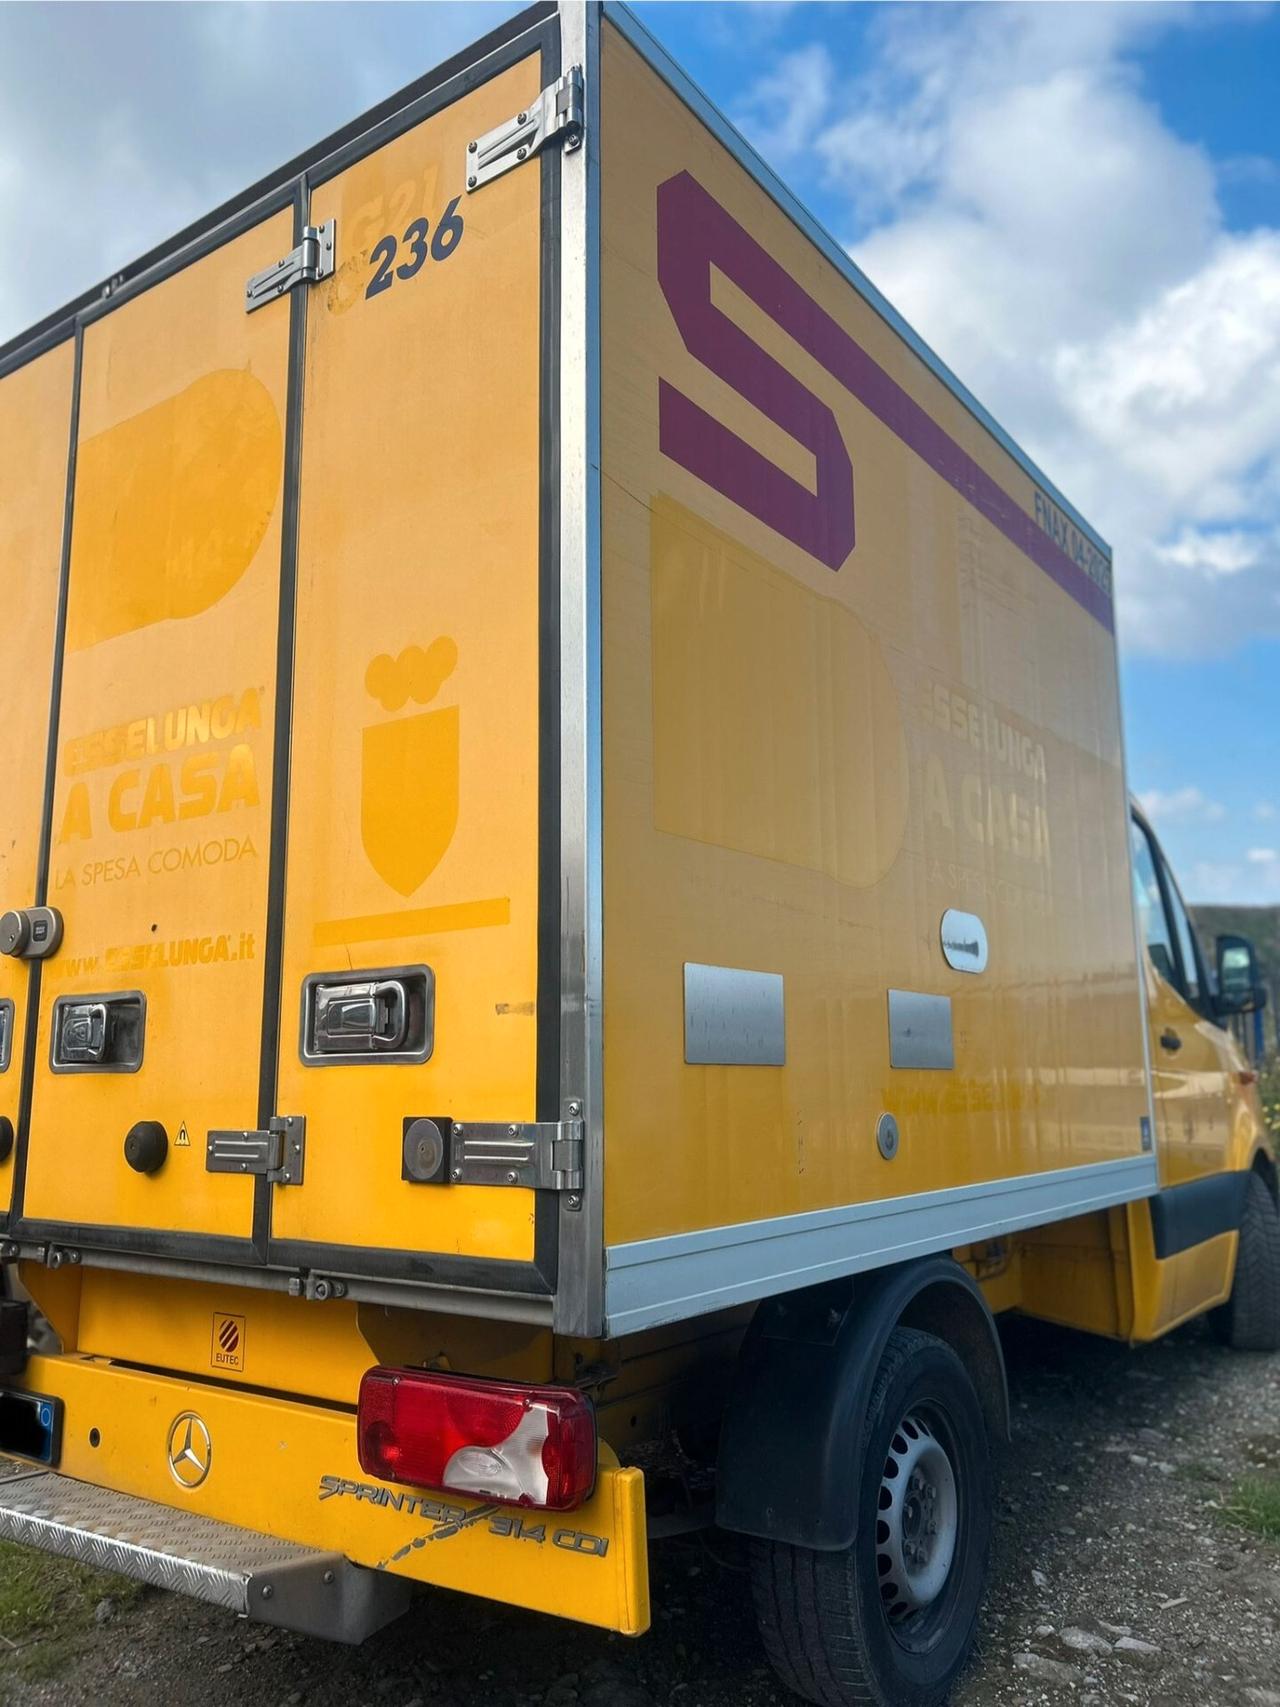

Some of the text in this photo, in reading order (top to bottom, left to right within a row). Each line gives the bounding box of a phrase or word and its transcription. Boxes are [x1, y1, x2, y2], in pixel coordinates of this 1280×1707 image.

[365, 195, 464, 300] 236
[58, 743, 260, 845] A CASA
[55, 834, 258, 890] LA SPESA COMODA
[215, 1352, 239, 1366] EUTEC
[319, 1475, 467, 1527] SPRINTER
[552, 1528, 609, 1558] CDI
